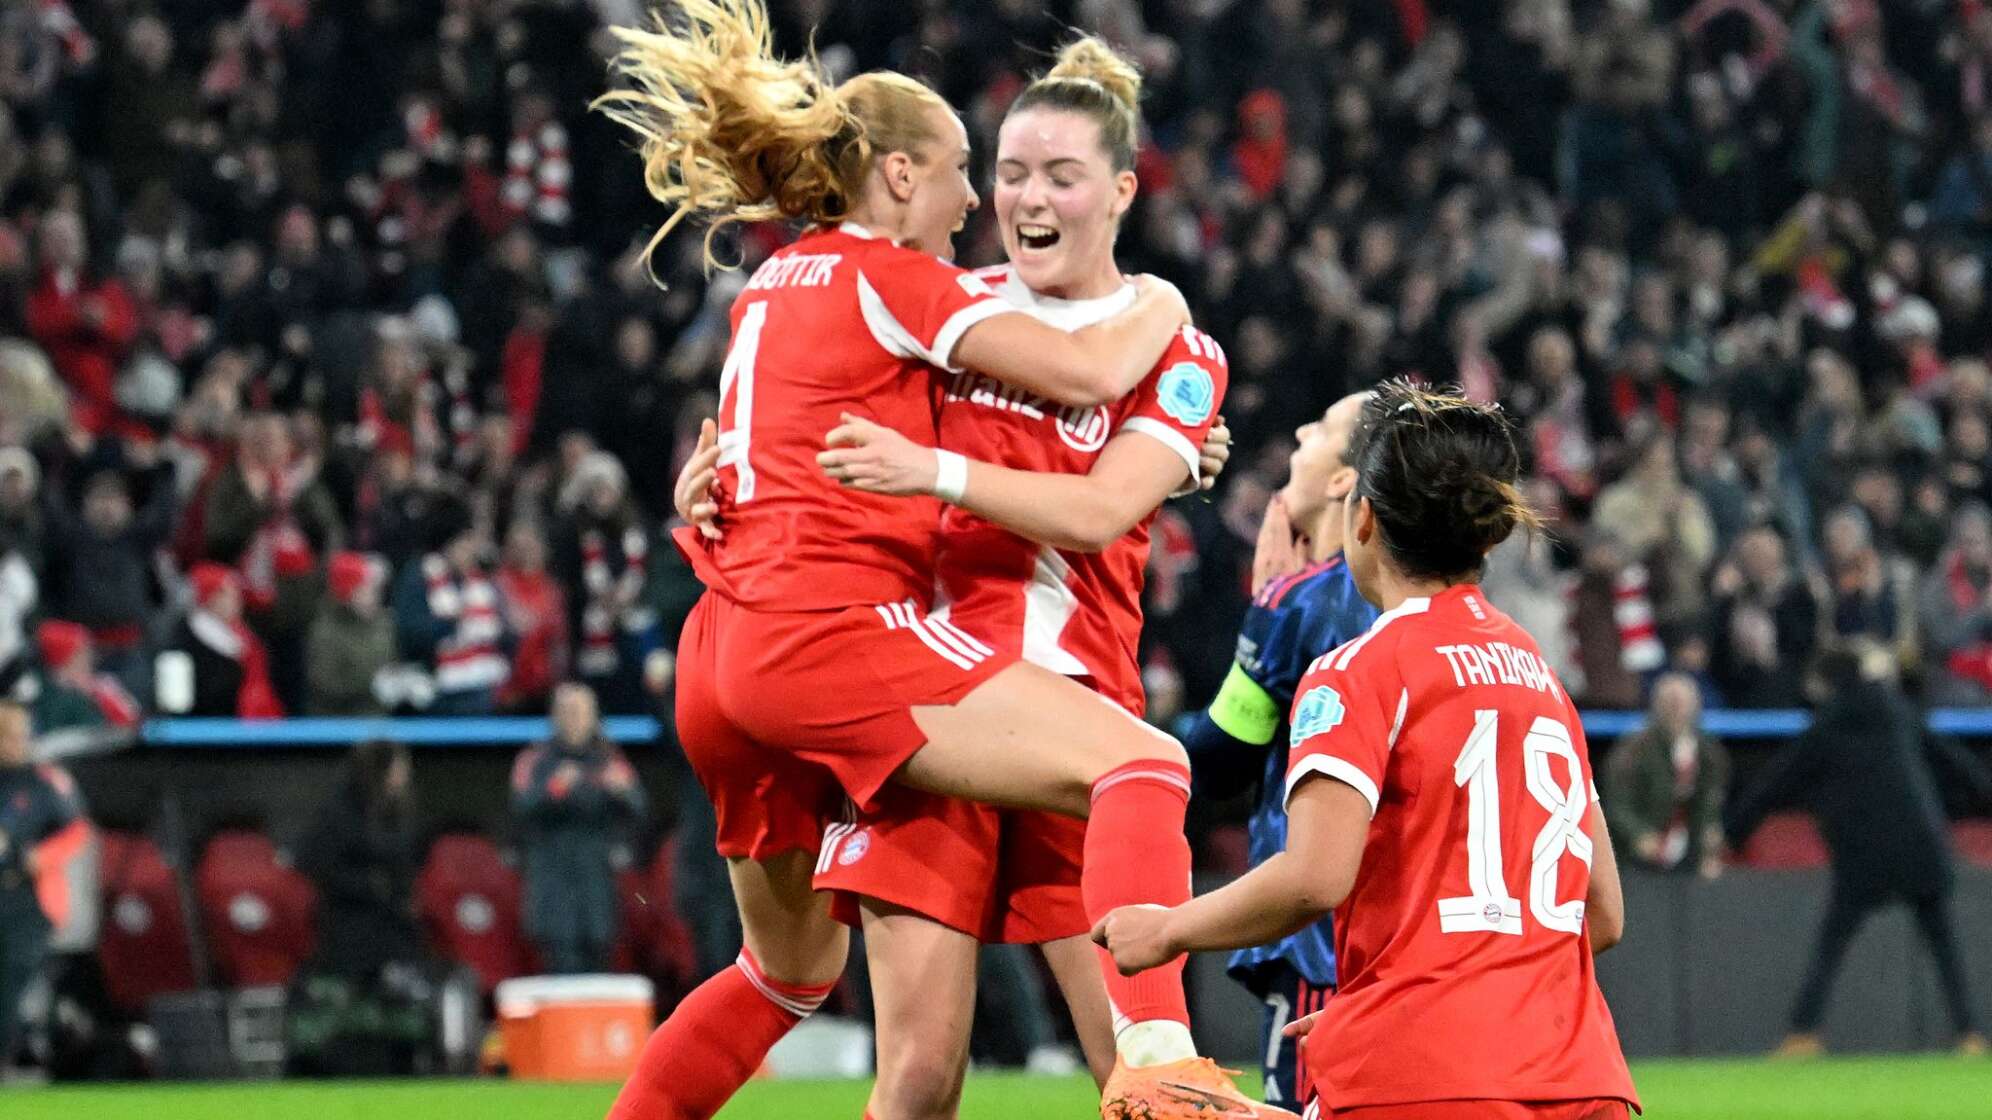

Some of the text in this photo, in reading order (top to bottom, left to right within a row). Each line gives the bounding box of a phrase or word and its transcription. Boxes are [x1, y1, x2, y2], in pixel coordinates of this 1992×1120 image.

[747, 251, 842, 290] DÓTTIR
[716, 301, 768, 504] 4
[1435, 642, 1563, 704] TANIKAW
[1438, 709, 1593, 935] 18
[1266, 992, 1290, 1069] 7
